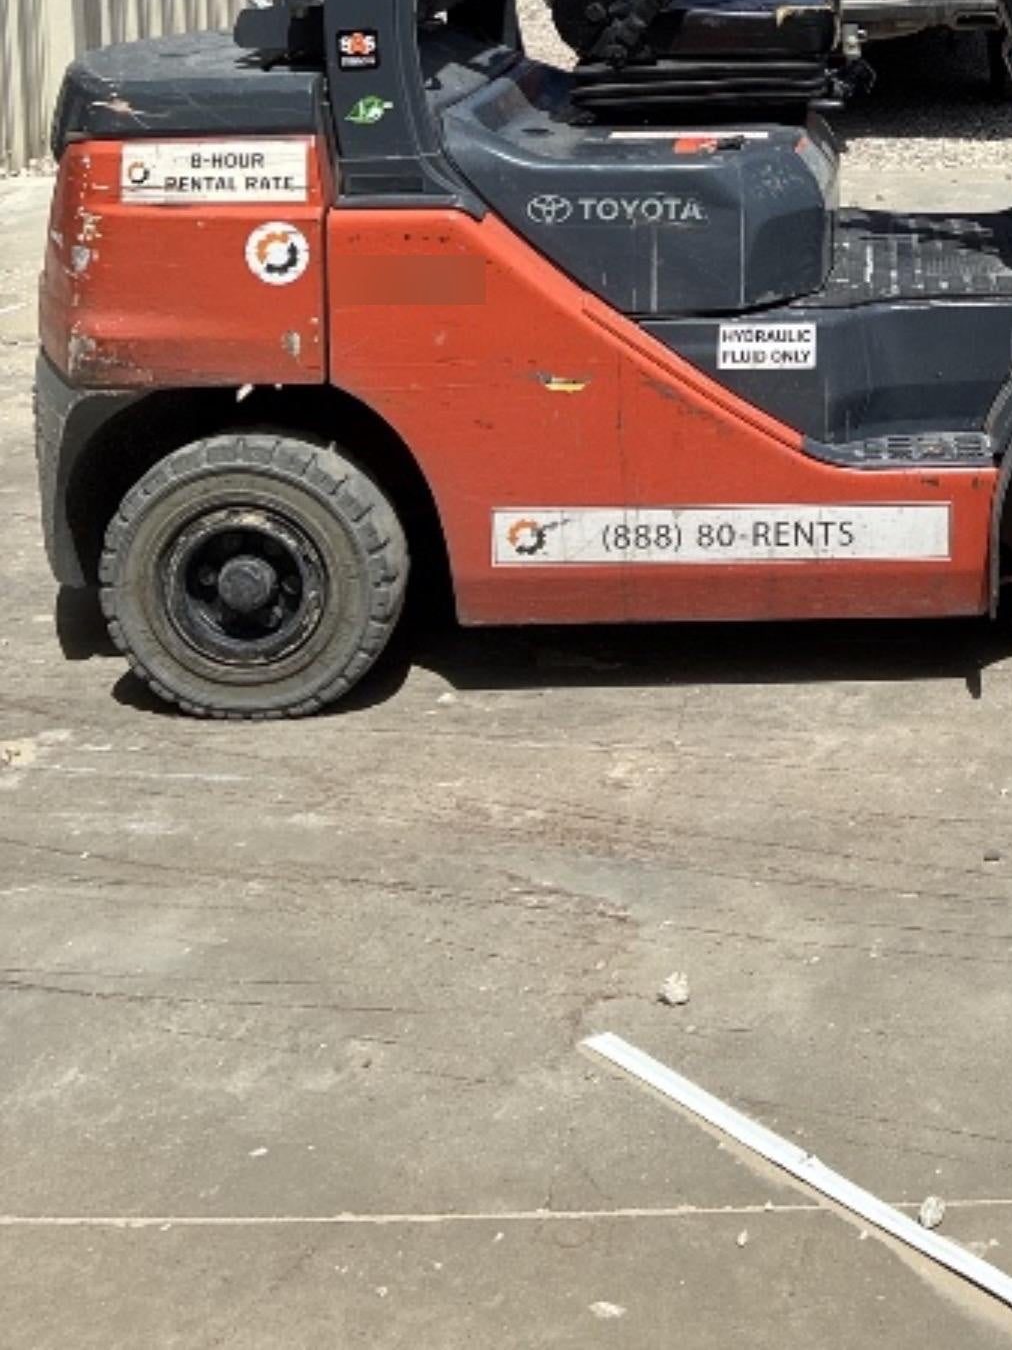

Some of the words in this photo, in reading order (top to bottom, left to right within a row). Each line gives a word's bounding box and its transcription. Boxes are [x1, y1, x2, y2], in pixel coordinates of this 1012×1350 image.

[163, 176, 237, 192] RENTAL
[245, 176, 296, 191] RATE
[578, 197, 704, 221] TOYOTA
[602, 522, 683, 551] (888)
[697, 520, 856, 548] 80-RENTS
